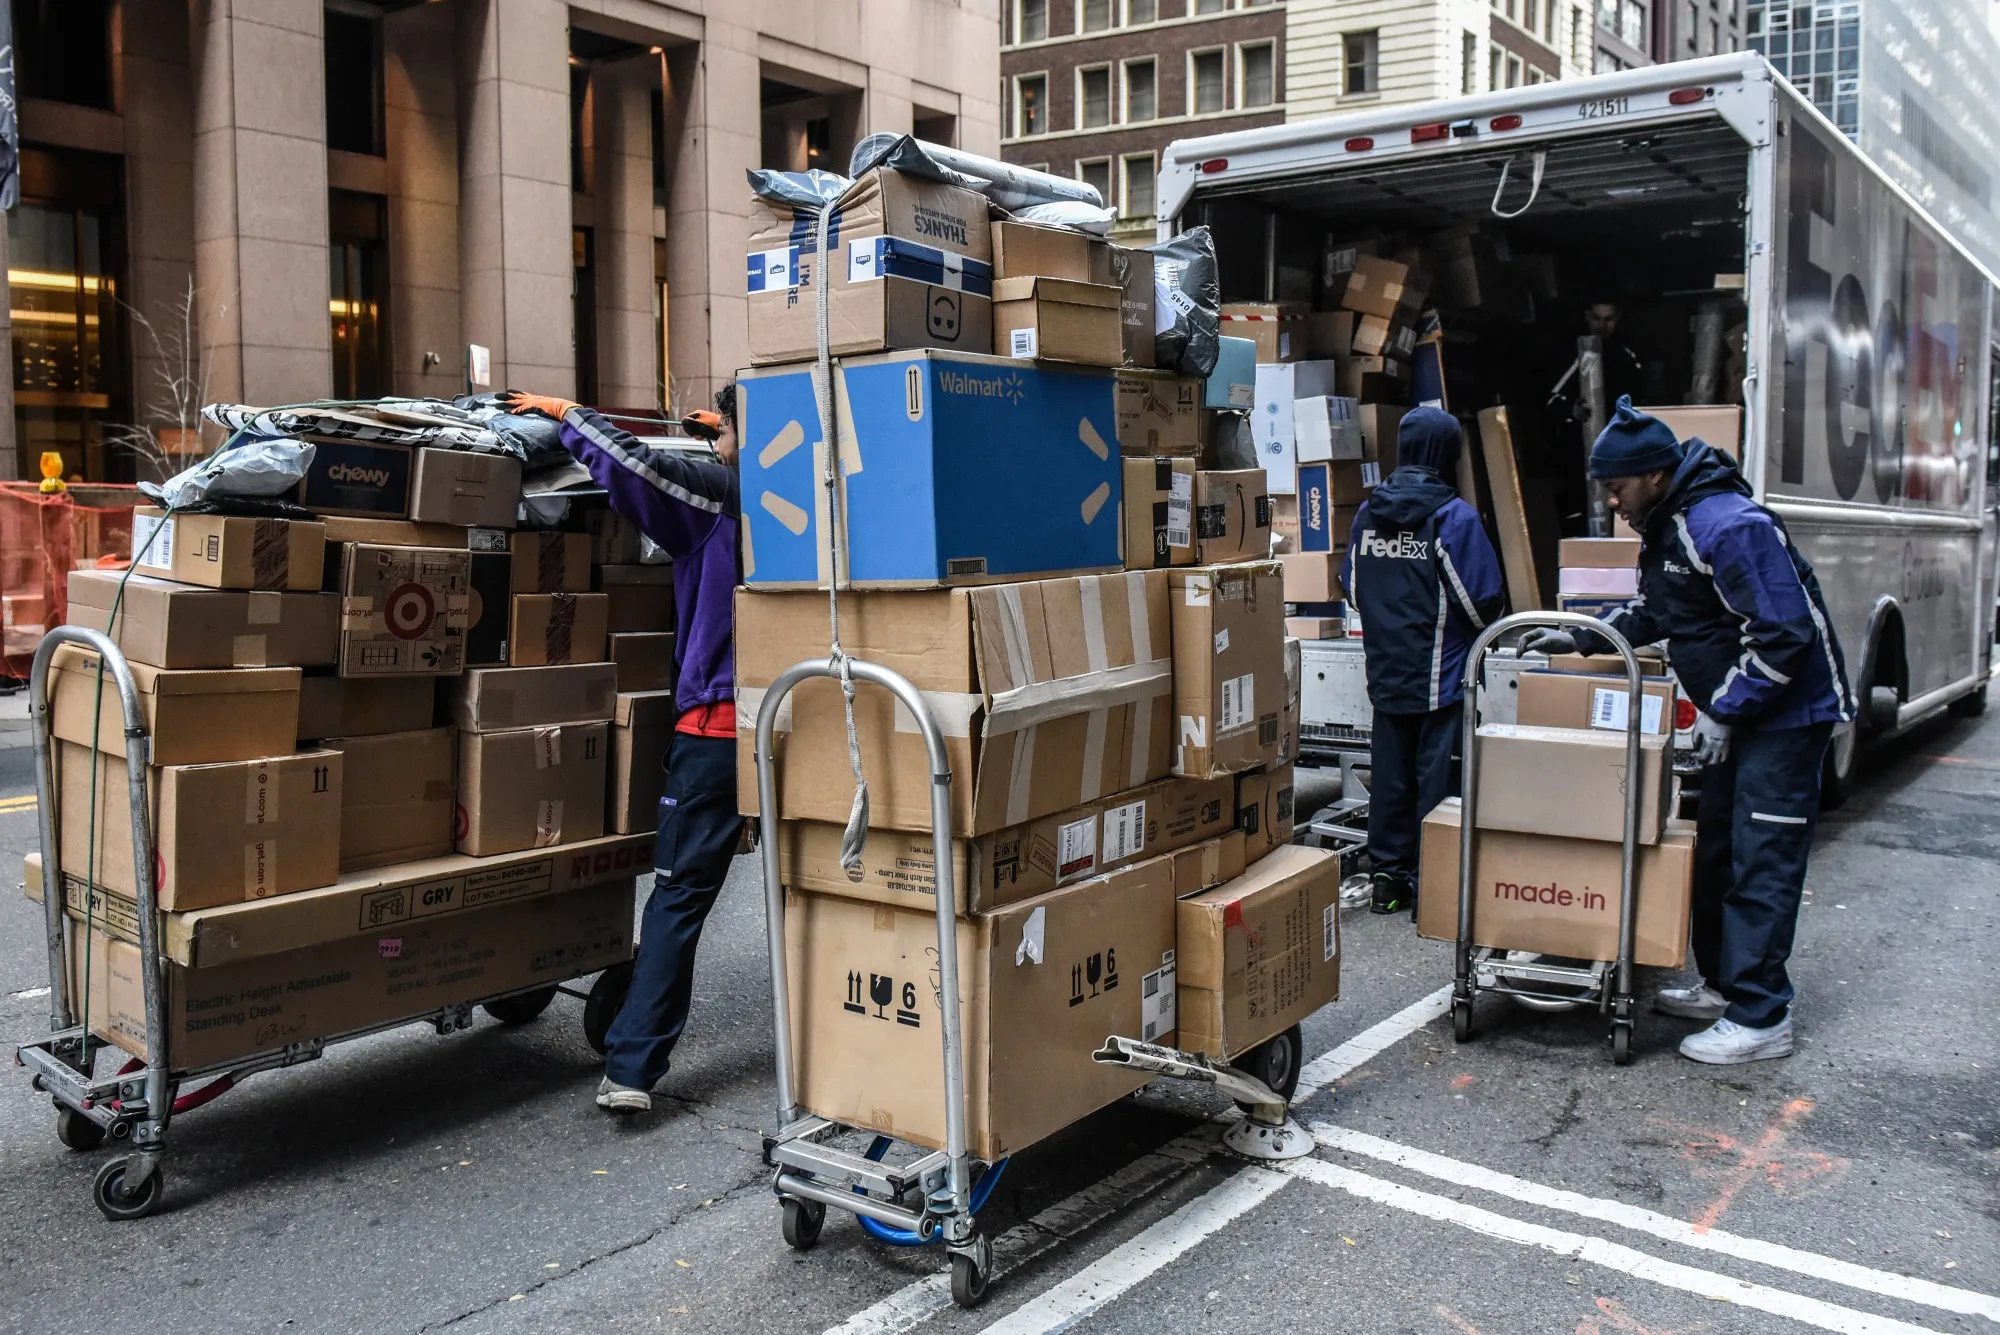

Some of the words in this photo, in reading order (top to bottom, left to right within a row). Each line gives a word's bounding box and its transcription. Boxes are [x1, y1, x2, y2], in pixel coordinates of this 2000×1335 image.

[1578, 96, 1628, 119] 421511
[915, 215, 969, 246] THANKS
[800, 265, 811, 287] I'M
[1171, 294, 1190, 311] 0145
[940, 371, 1004, 397] Walmart
[328, 463, 389, 487] chewy
[1311, 486, 1321, 531] chewy
[1360, 529, 1428, 560] FedEx
[878, 870, 894, 878] Lamp
[894, 872, 908, 880] Floor
[910, 874, 922, 882] Arch
[85, 893, 102, 911] RY
[422, 886, 455, 907] GRY
[466, 891, 481, 903] LOT
[1107, 947, 1116, 974] 6
[185, 992, 236, 1013] Electric
[240, 984, 283, 1004] Height
[286, 969, 352, 993] Adjustable
[902, 982, 916, 1010] 6
[185, 1009, 245, 1032] Standing
[250, 1002, 283, 1020] Desk
